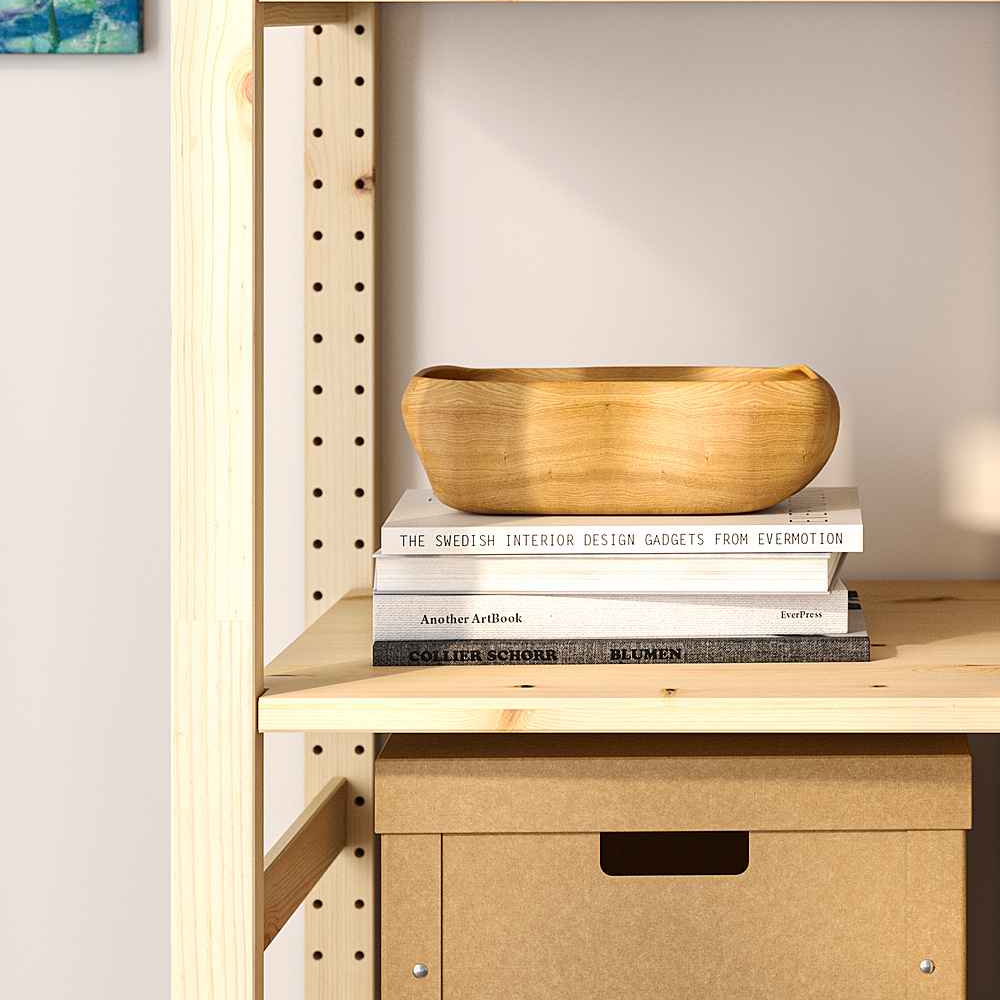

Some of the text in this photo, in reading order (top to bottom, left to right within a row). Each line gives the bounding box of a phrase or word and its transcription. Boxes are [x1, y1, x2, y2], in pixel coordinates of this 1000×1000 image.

[400, 532, 844, 547] THE SWEDISH INTERIOR DESIGN GADGETS FROM EVERMOTION
[420, 613, 523, 625] Another ArtBook
[780, 610, 823, 619] EverPress
[408, 648, 682, 662] COLLIER SCHORR BLUMEN
